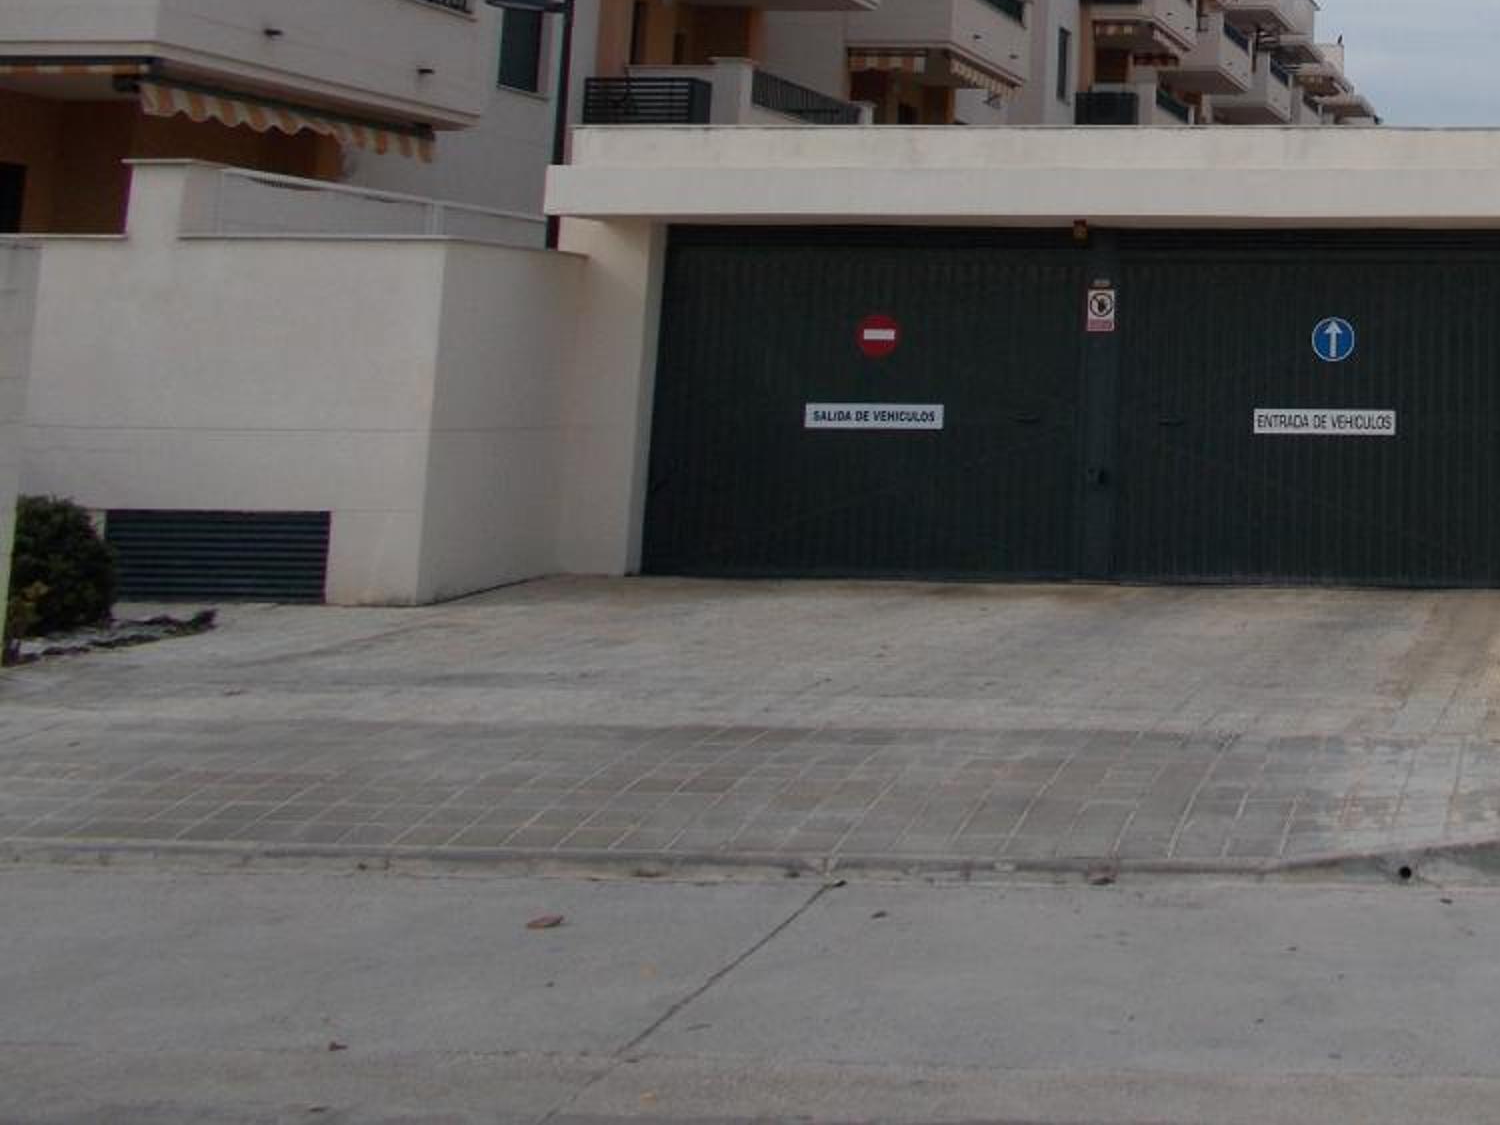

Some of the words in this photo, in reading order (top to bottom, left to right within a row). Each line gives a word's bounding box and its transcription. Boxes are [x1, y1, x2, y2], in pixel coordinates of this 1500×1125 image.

[813, 410, 851, 422] SALIDA
[855, 410, 870, 422] DE
[873, 410, 935, 423] VEHICULOS
[1257, 414, 1309, 428] ENTRADA
[1313, 414, 1328, 428] DE
[1331, 414, 1392, 430] VEHICULOS
